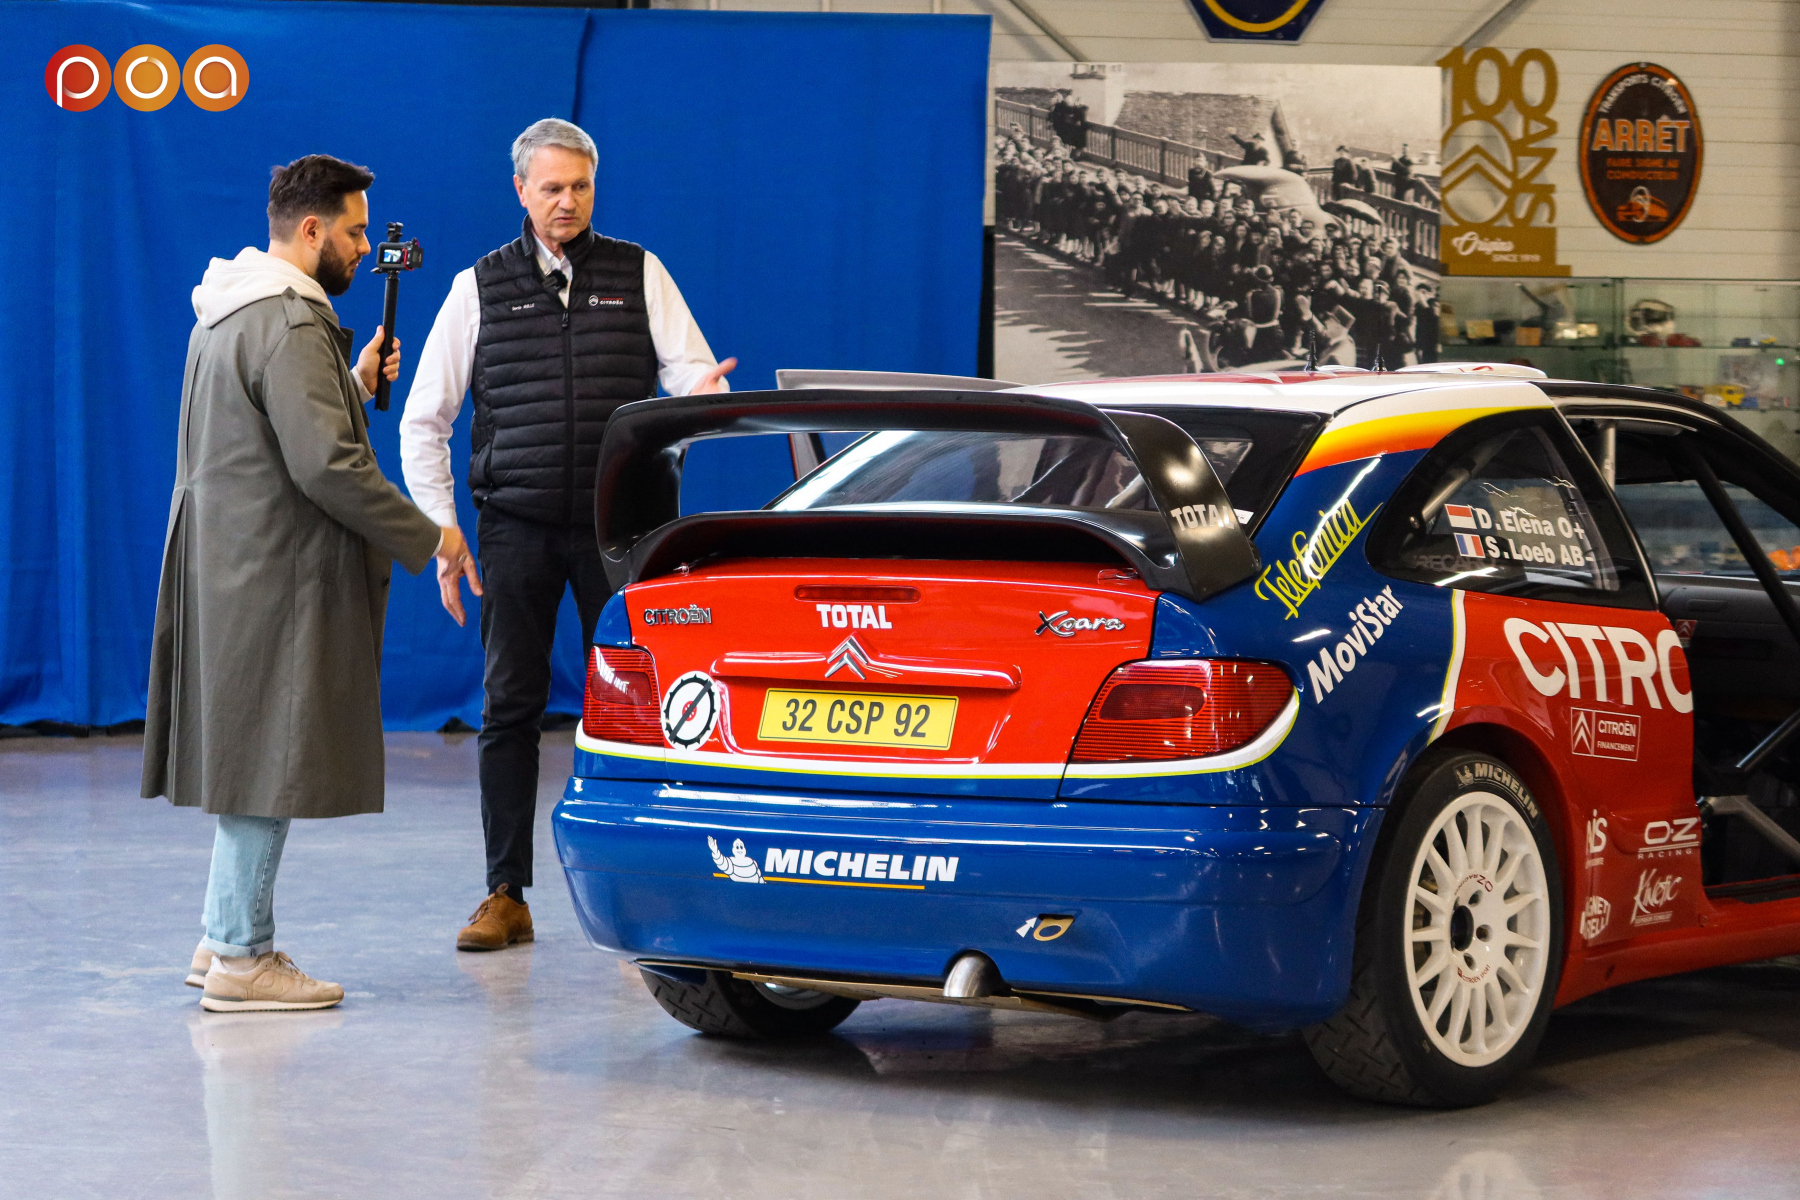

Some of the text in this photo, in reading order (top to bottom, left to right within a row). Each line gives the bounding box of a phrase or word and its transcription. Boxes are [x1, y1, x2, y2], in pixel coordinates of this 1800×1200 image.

[1436, 46, 1559, 125] 100
[1592, 114, 1691, 153] ARRÊT
[1170, 503, 1235, 532] TOTAL
[643, 603, 712, 626] CITROËN
[816, 603, 893, 629] TOTAL
[1306, 583, 1404, 705] MoviStar
[782, 698, 931, 739] 32 CSP 92
[1597, 719, 1637, 738] CITROËN
[1596, 740, 1636, 753] FINANCEMENT
[1474, 762, 1539, 819] MICHELIN
[764, 847, 960, 883] MICHELIN
[1637, 848, 1693, 860] RACING
